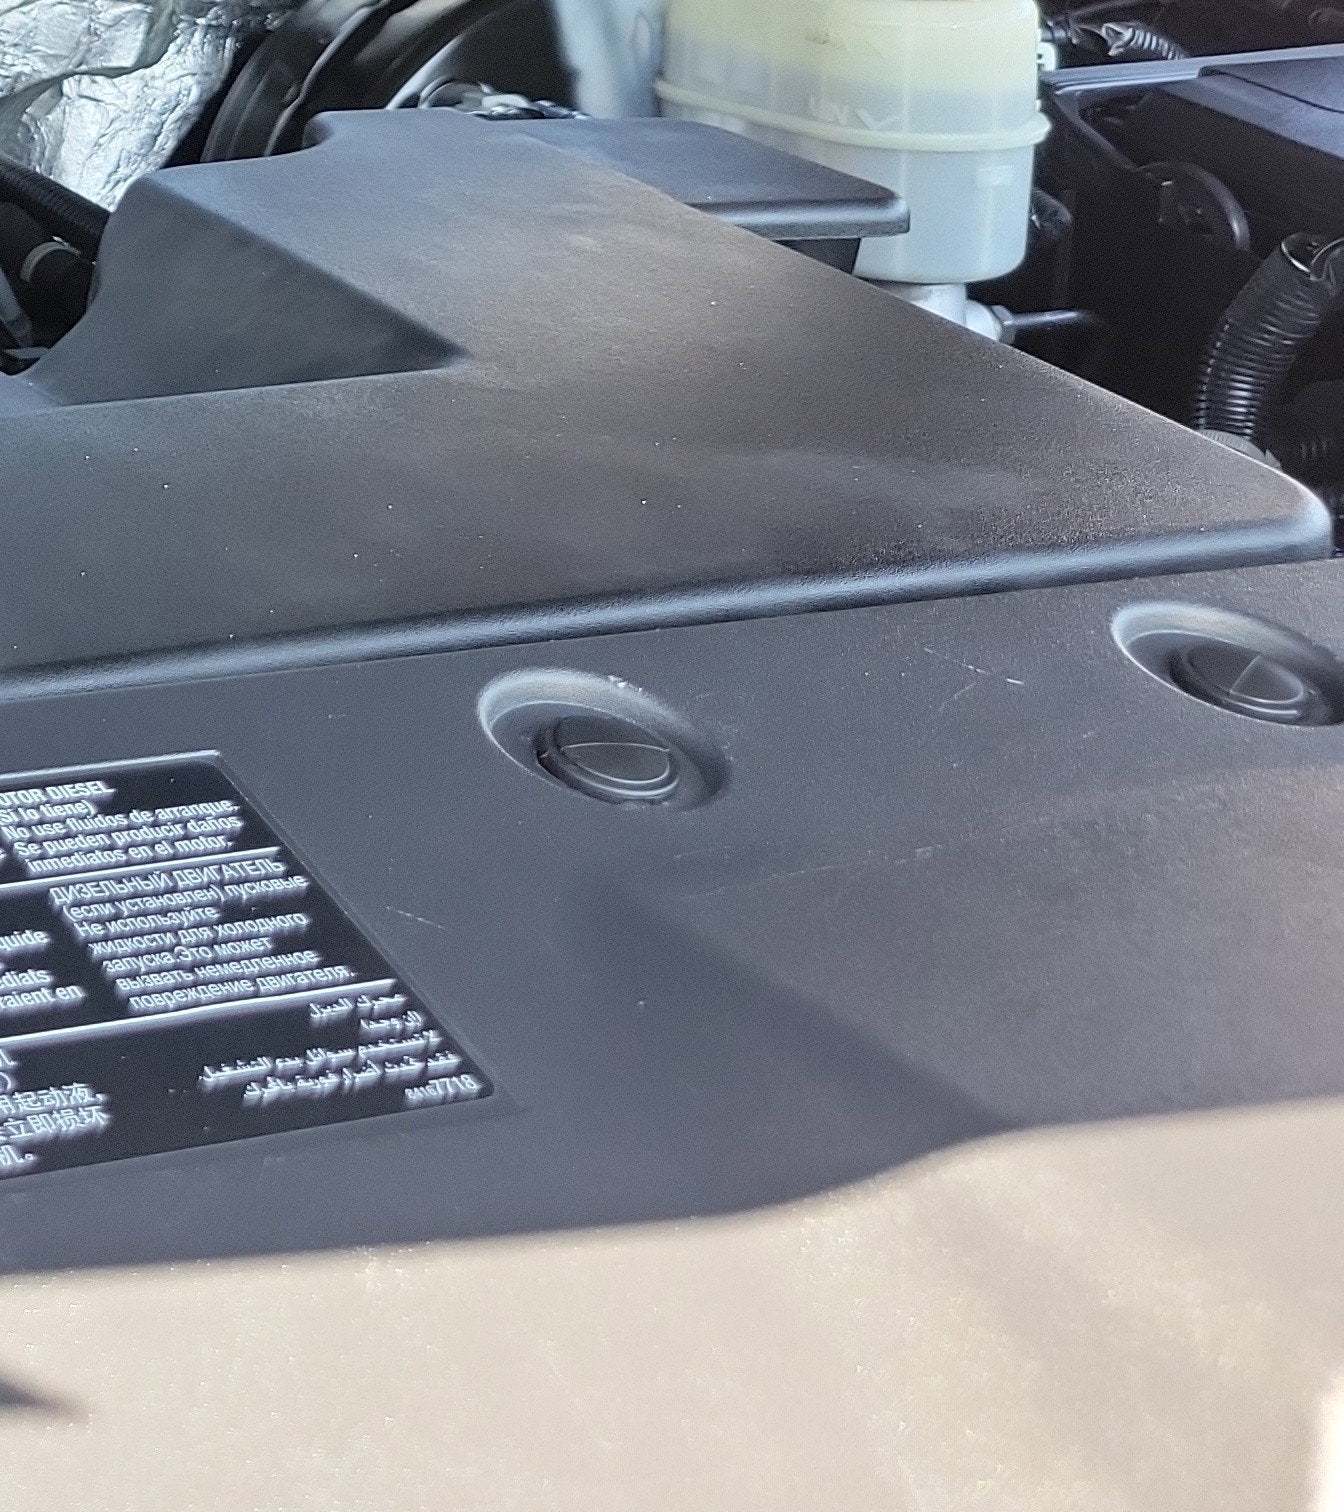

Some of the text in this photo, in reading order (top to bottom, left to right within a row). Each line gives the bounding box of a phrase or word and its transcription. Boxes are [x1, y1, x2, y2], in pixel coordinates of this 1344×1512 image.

[17, 807, 41, 821] lo
[39, 799, 97, 819] tiene)
[45, 780, 116, 801] DIESEL
[0, 800, 240, 841] No use fluidos de arranque.
[13, 816, 244, 857] Se pueden producir daños
[25, 835, 233, 873] inmediatos en el motor.
[49, 858, 286, 905] ДИЗЕЛЬНЫЙ ДВИГАТЕЛЬ
[62, 875, 309, 923] (если установлен) пусковые
[73, 906, 220, 938] Не используйте
[88, 913, 309, 955] жидкости для холодного
[213, 937, 273, 957] может
[116, 950, 320, 991] вызвать немедленное
[130, 965, 356, 1010] повреждение двигателя.
[55, 985, 85, 1001] en
